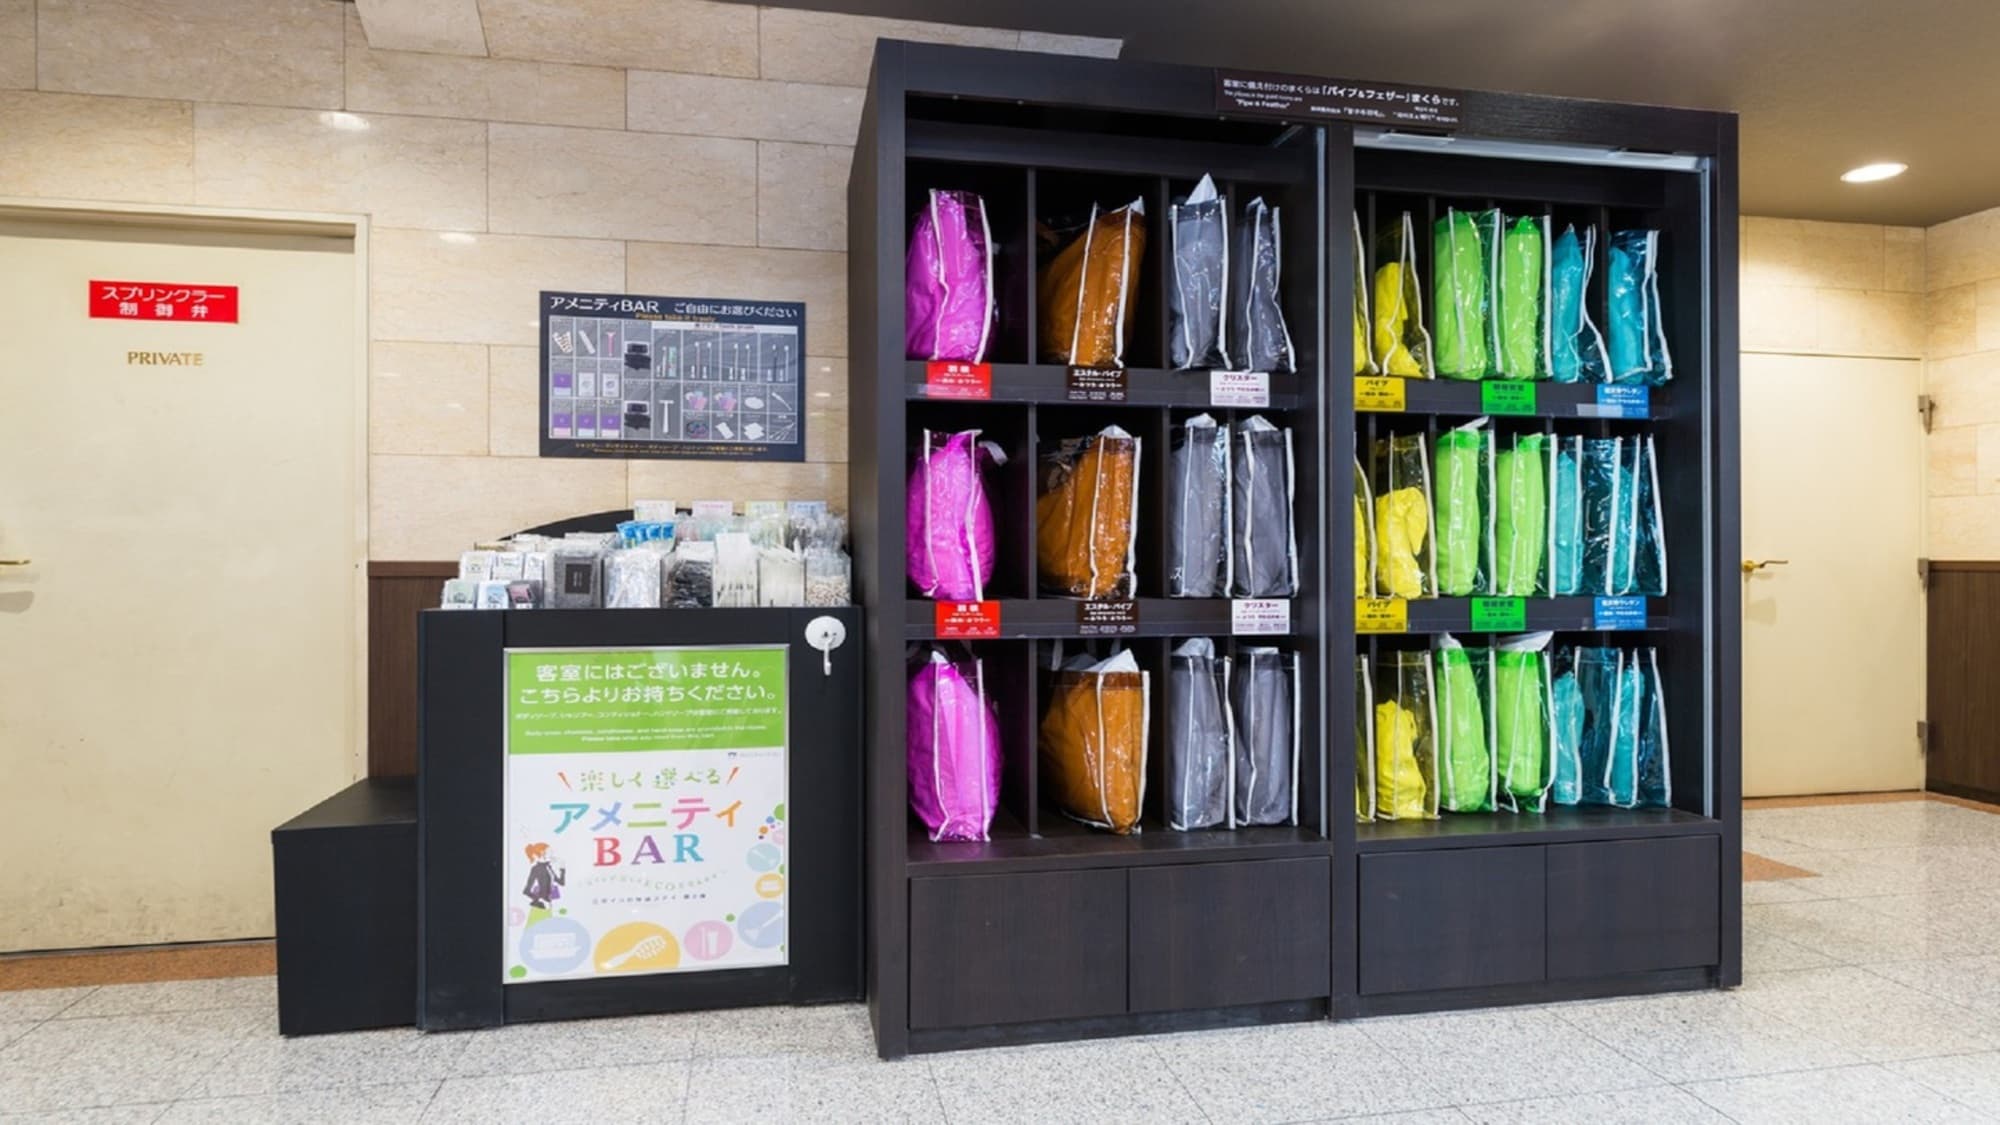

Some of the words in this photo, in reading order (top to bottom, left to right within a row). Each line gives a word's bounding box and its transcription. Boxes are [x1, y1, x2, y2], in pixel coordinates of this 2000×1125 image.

[102, 286, 225, 303] スプリンクラー
[550, 296, 660, 313] アメニティBAR
[674, 302, 798, 318] ご自由にお選びください
[127, 351, 203, 366] PRIVATE
[536, 661, 761, 682] 客室にはございません。
[519, 684, 775, 704] こちらよりお持ちください。
[580, 767, 721, 791] 楽しく選べる
[549, 798, 743, 834] アメニティ
[593, 833, 705, 867] BAR
